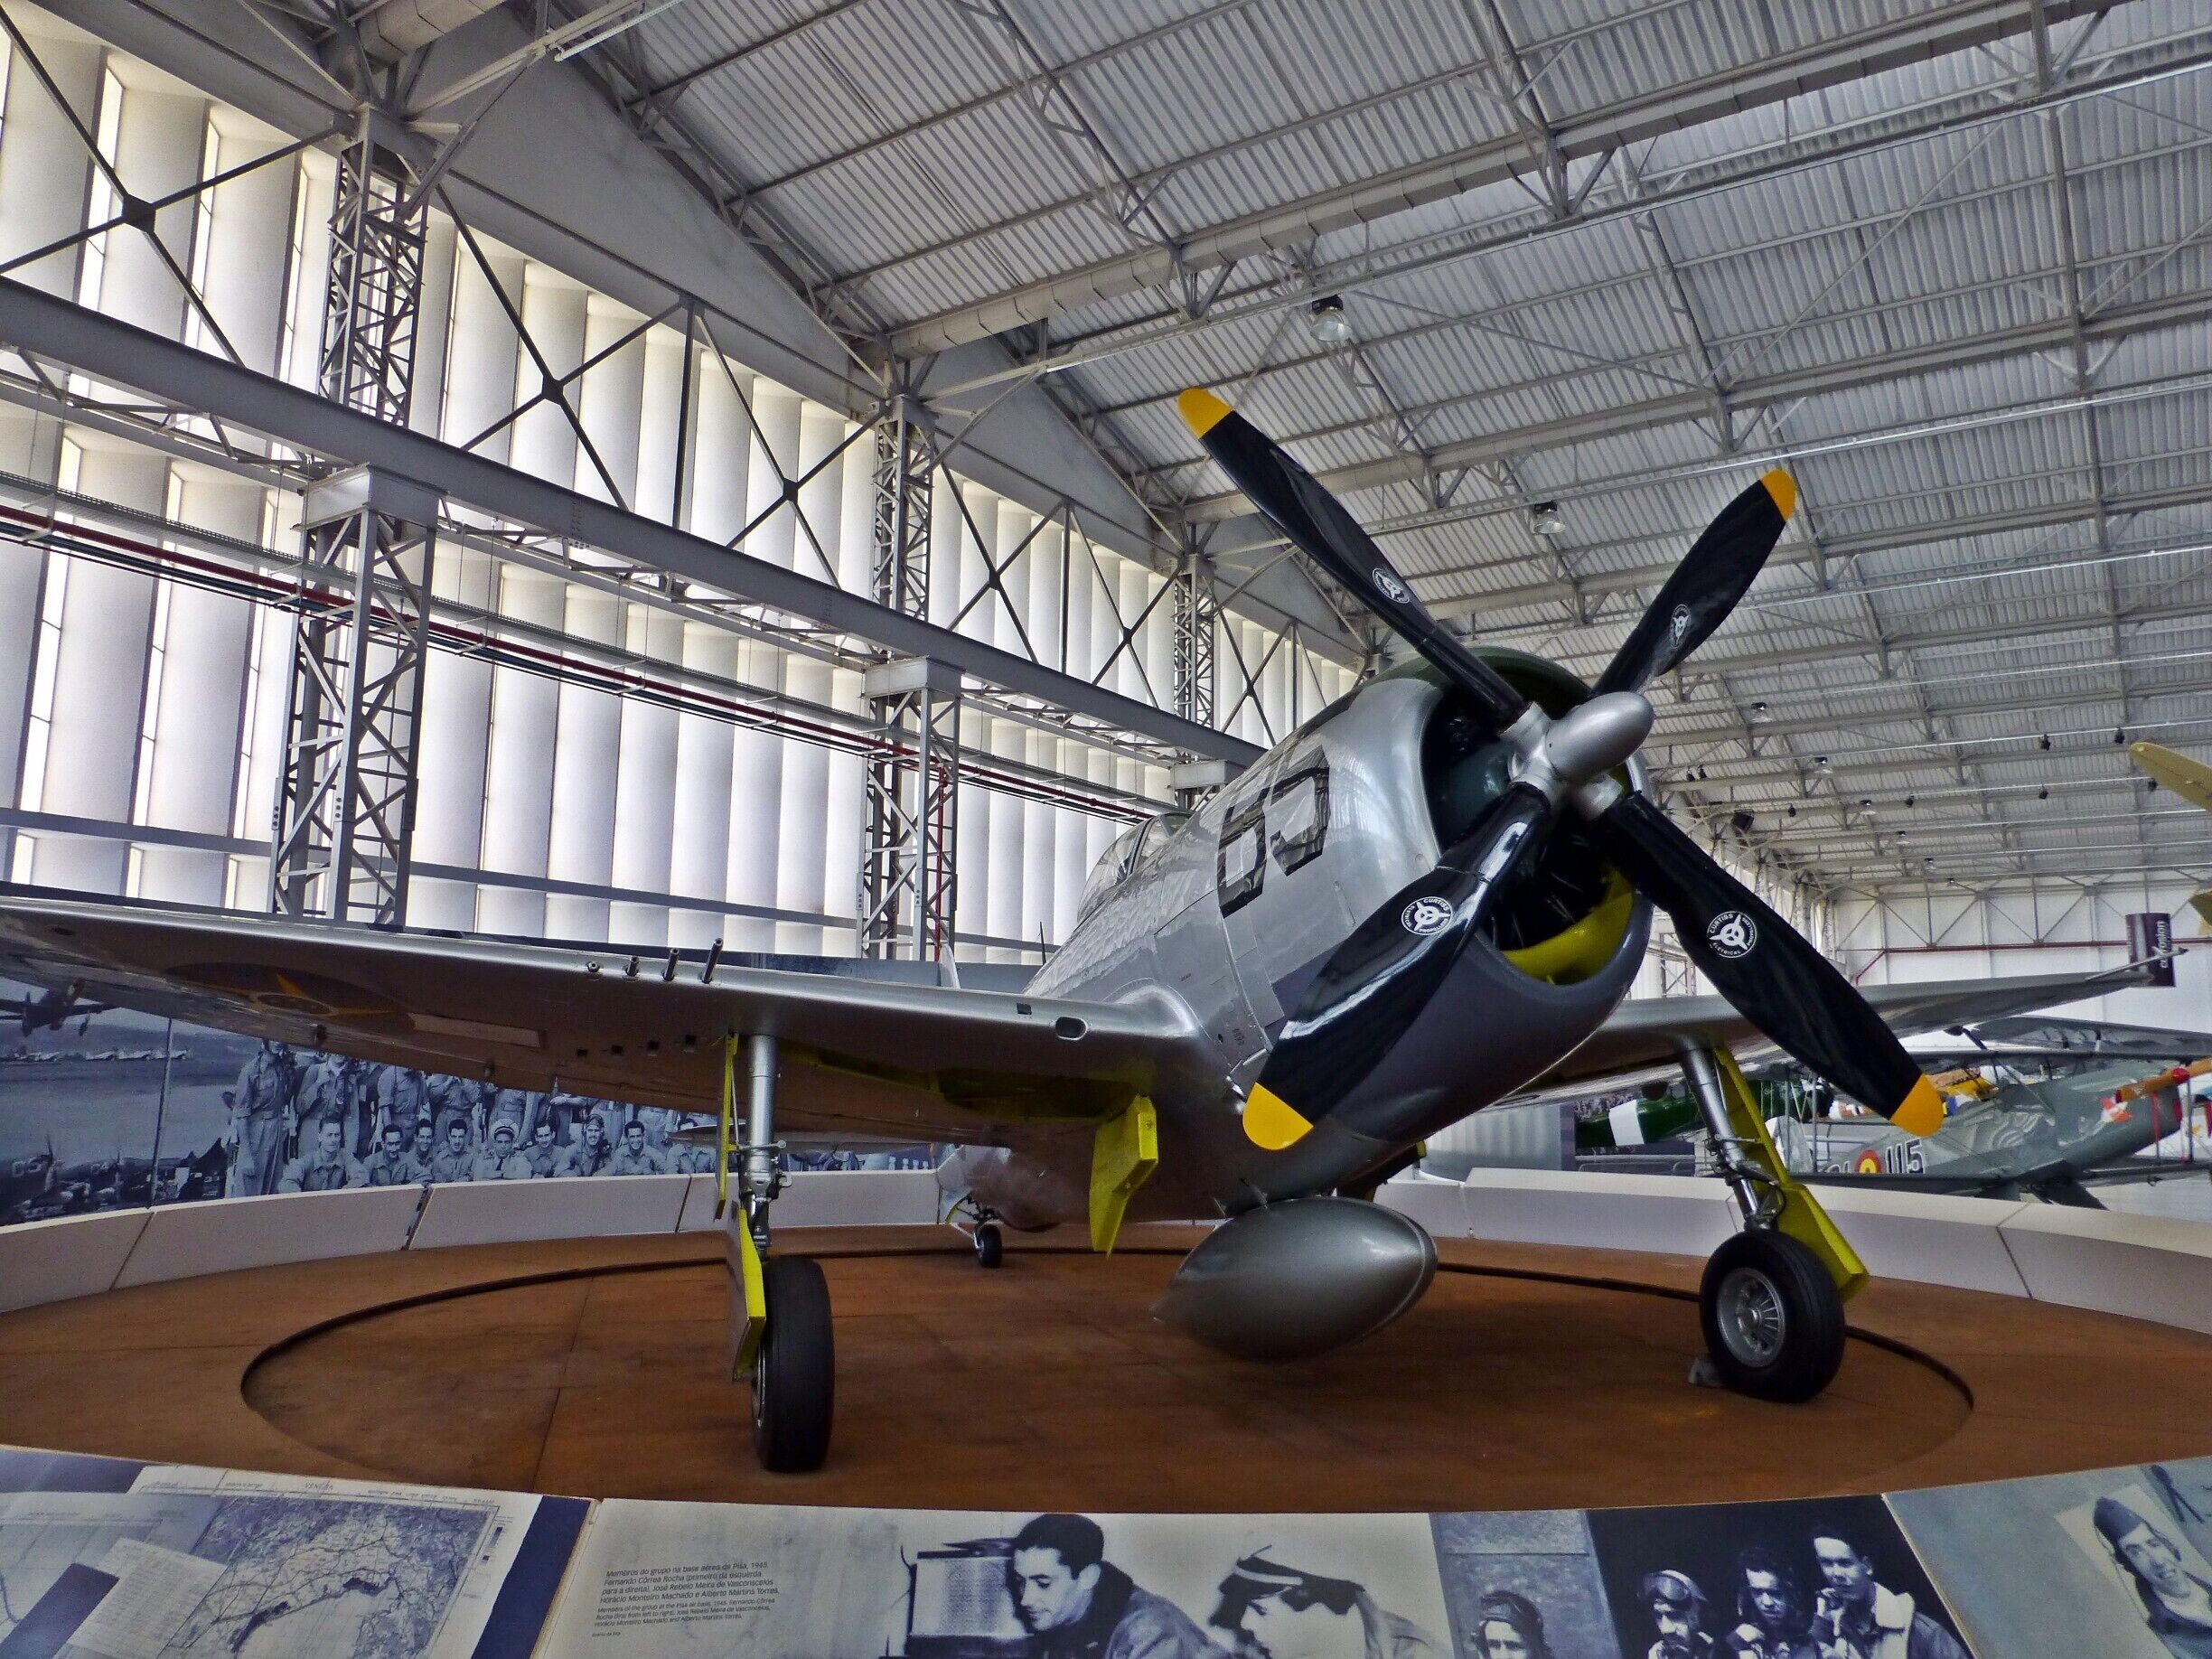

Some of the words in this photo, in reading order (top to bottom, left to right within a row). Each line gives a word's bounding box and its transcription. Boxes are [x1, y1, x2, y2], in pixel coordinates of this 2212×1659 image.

[1423, 898, 1449, 911] CURTISS
[1710, 913, 1733, 933] CURTISS
[1884, 1139, 1926, 1174] 115
[651, 1567, 670, 1576] grupo
[722, 1562, 731, 1570] de
[605, 1578, 636, 1586] Fernando
[663, 1575, 685, 1583] Rocha
[729, 1570, 762, 1579] esquerda
[601, 1588, 618, 1596] para
[628, 1593, 660, 1602] Monteiro
[661, 1591, 693, 1599] Machado
[701, 1589, 726, 1598] Alberto
[728, 1588, 755, 1596] Martins
